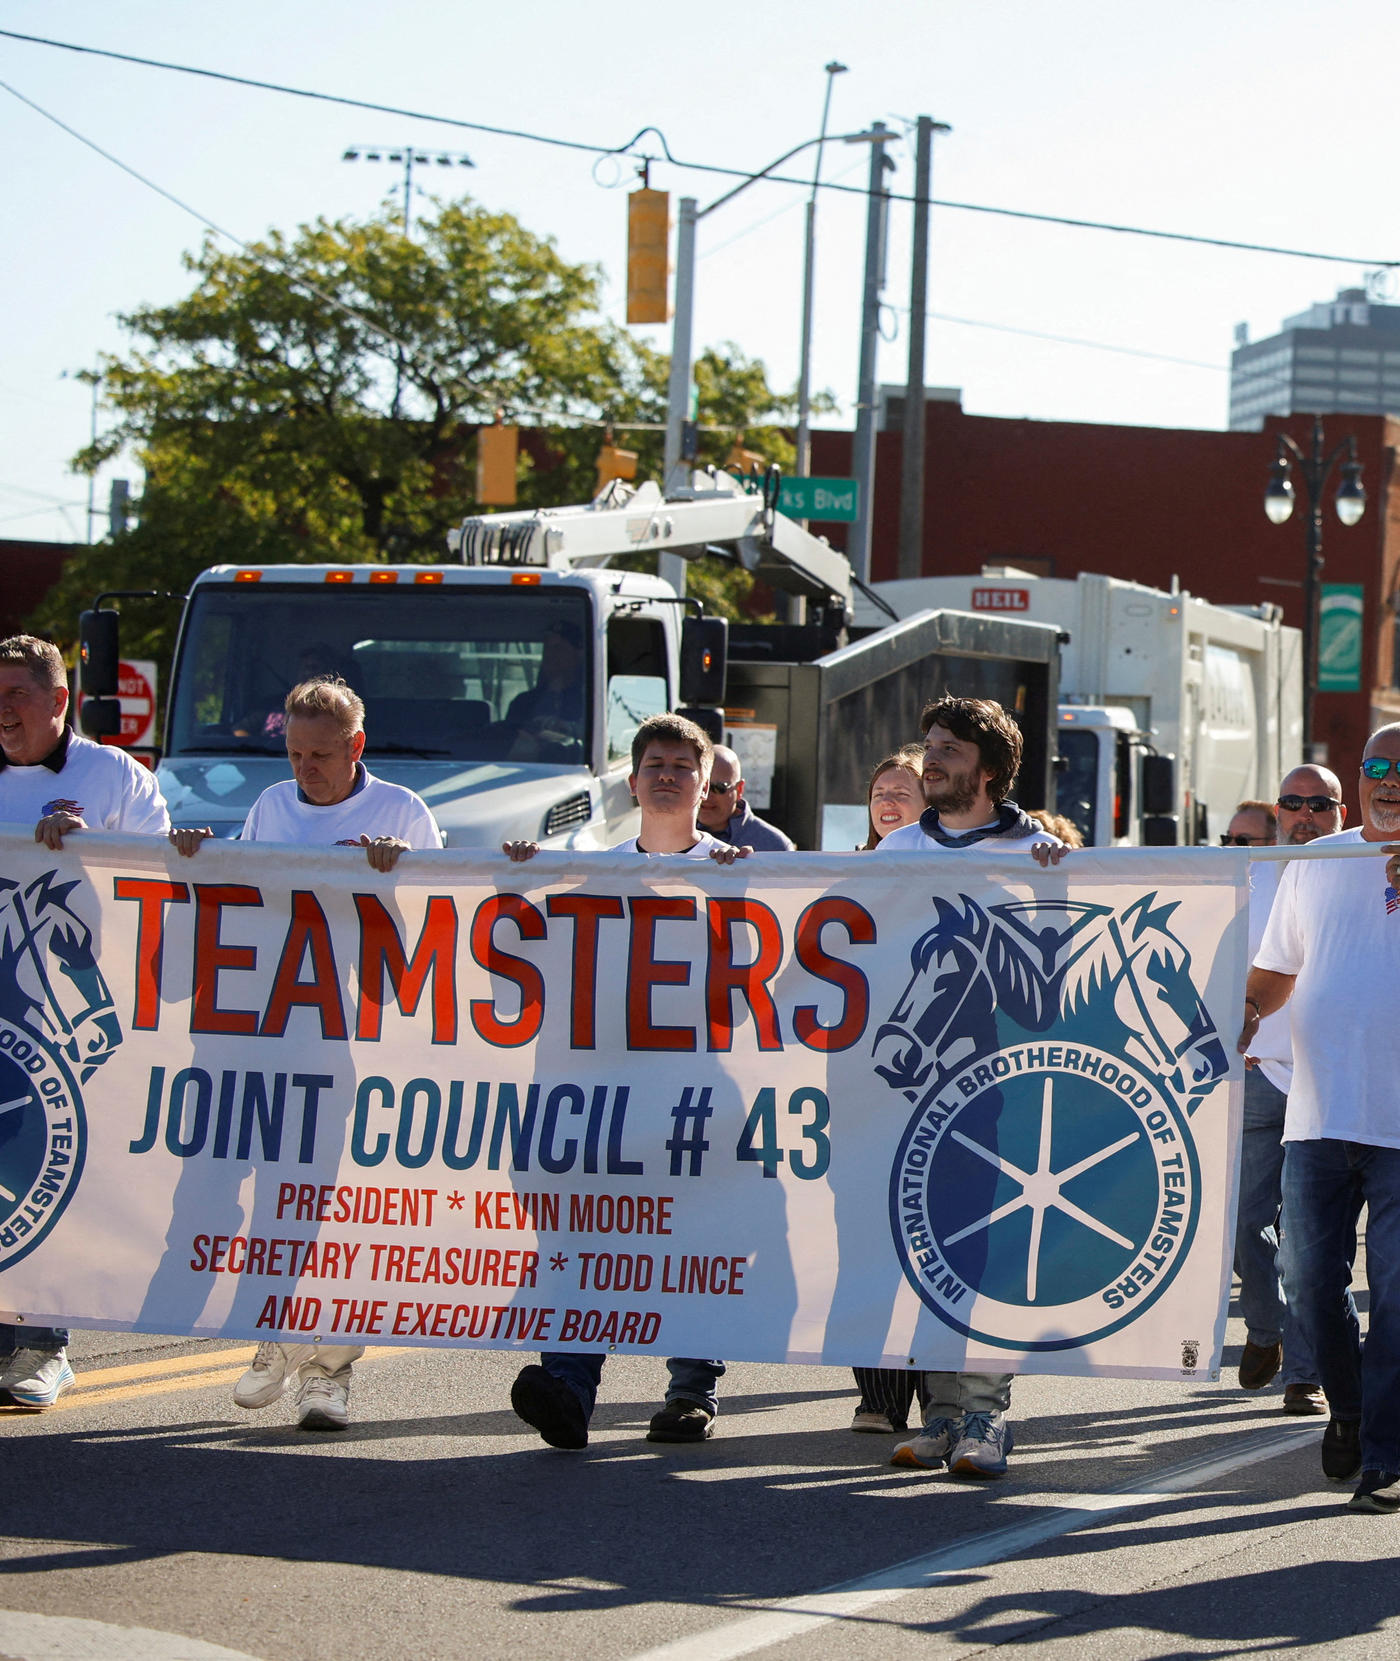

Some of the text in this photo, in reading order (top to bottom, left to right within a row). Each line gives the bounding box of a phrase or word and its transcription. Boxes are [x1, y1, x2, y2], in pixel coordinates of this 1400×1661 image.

[814, 487, 853, 511] Blvd
[975, 591, 1025, 608] HEIL
[113, 876, 878, 1053] TEAMSTERS
[39, 1076, 69, 1111] OF
[128, 1065, 832, 1181] JOINT COUNCIL # 43
[0, 1117, 73, 1252] TEAMSTER
[903, 1047, 1186, 1310] INTERNATIONAL BROTHERHOOD OF TEAMSTERS
[276, 1182, 675, 1235] PRESIDENT KEVIN MOORE
[190, 1234, 747, 1295] SECRETARY TREASURER TODD LINCE
[255, 1295, 663, 1345] AND THE EXECUTIVE BOARD
